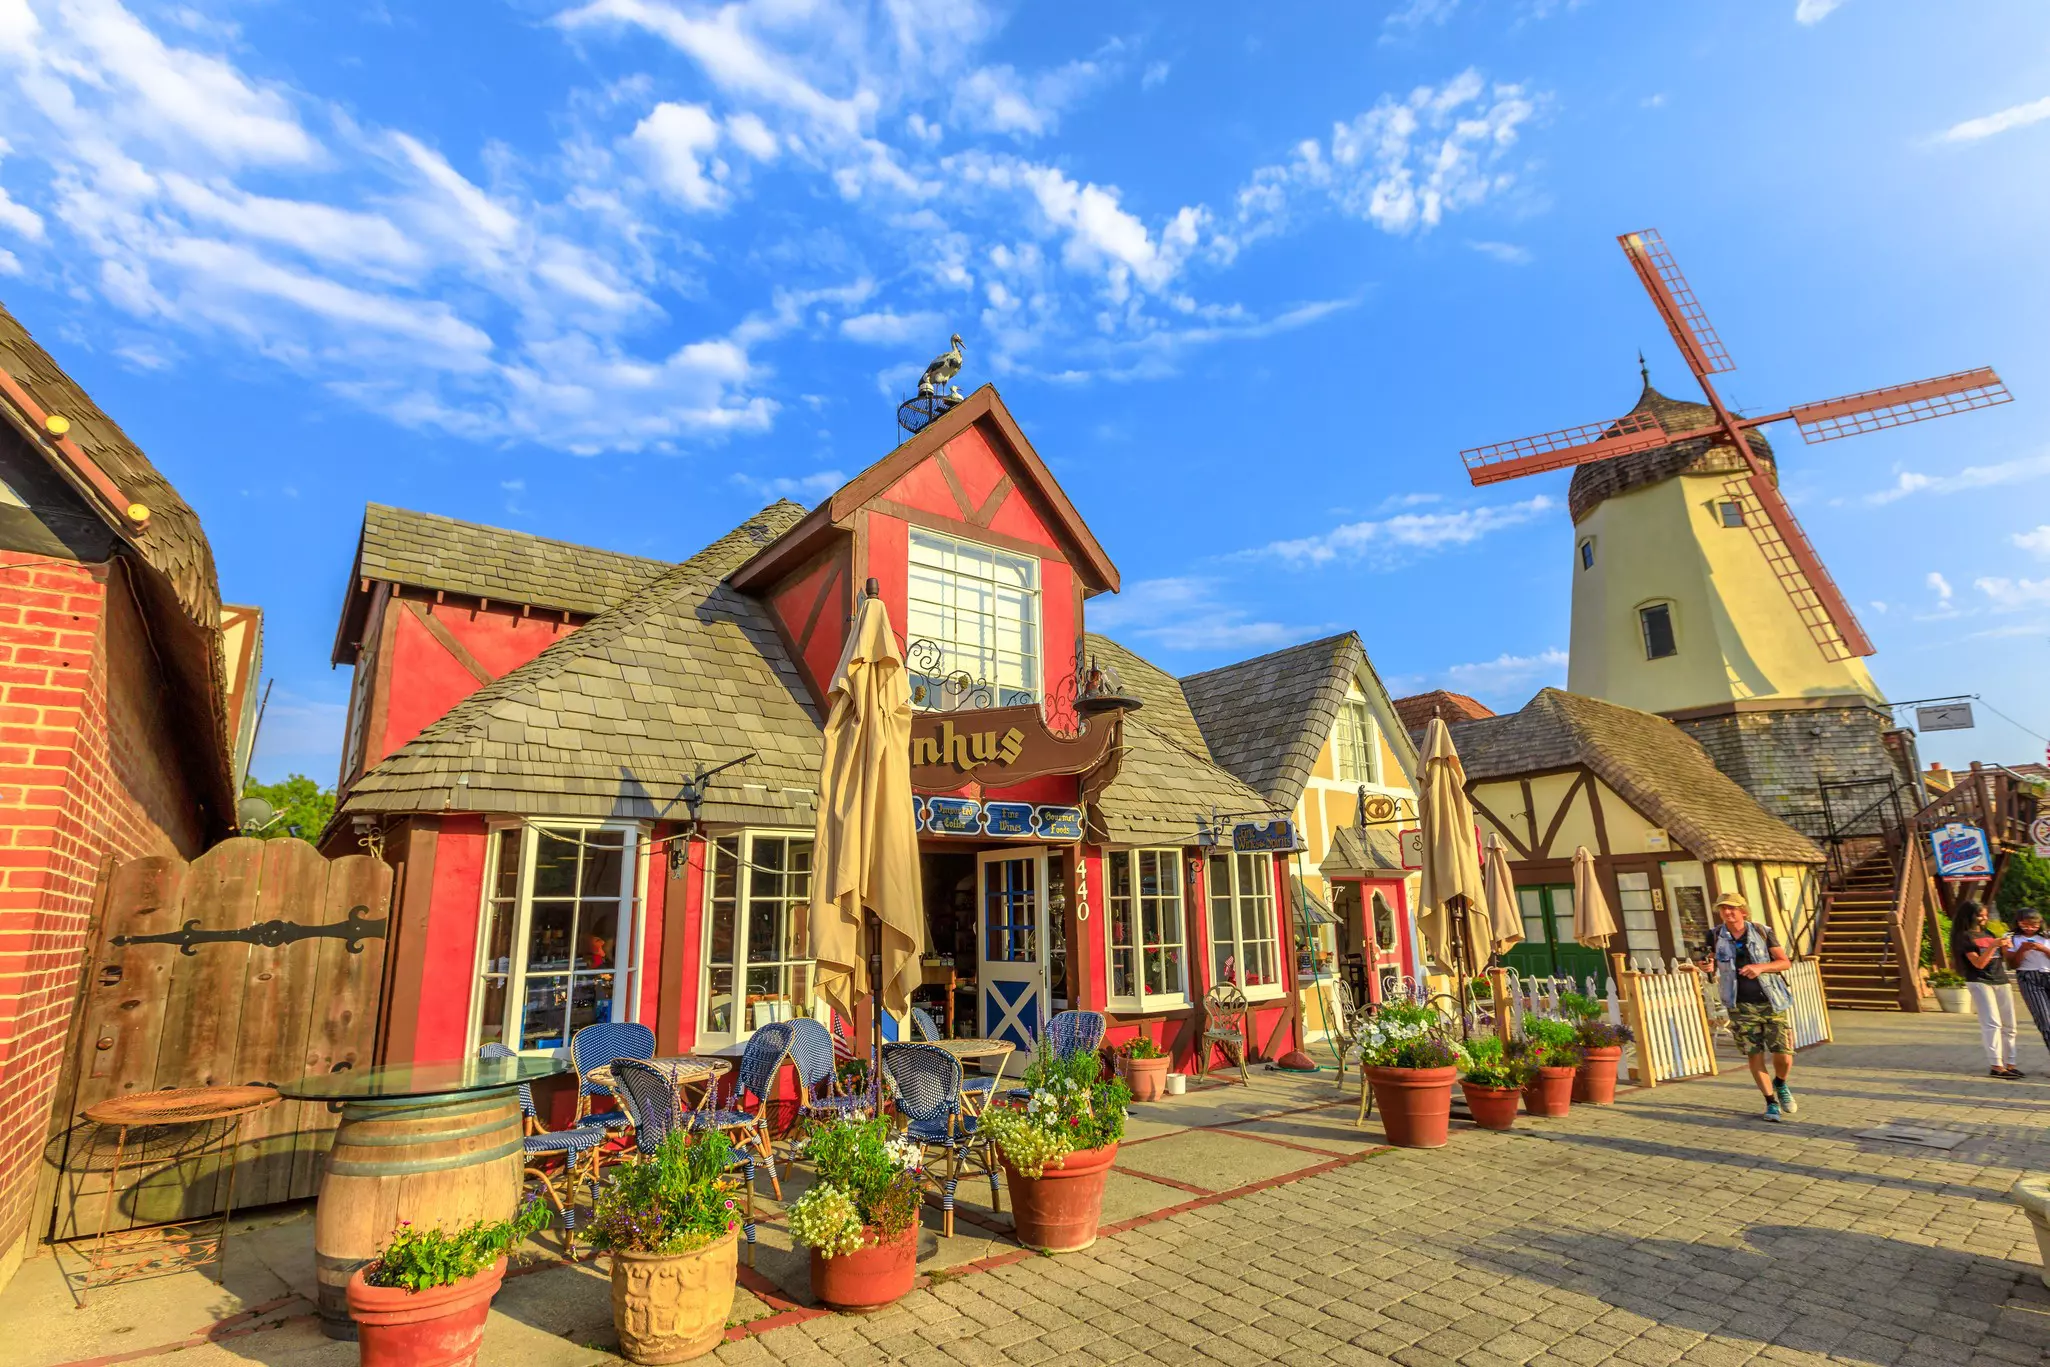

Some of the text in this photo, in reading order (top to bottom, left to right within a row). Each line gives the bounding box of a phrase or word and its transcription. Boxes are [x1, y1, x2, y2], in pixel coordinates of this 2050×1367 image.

[913, 720, 1025, 770] nhus
[937, 803, 973, 816] Imported
[1001, 807, 1019, 819] Fine
[1045, 811, 1075, 822] Gourmet
[943, 819, 966, 829] Coffee
[999, 821, 1022, 832] Wines
[1050, 823, 1070, 835] Foods
[1076, 859, 1090, 920] 440
